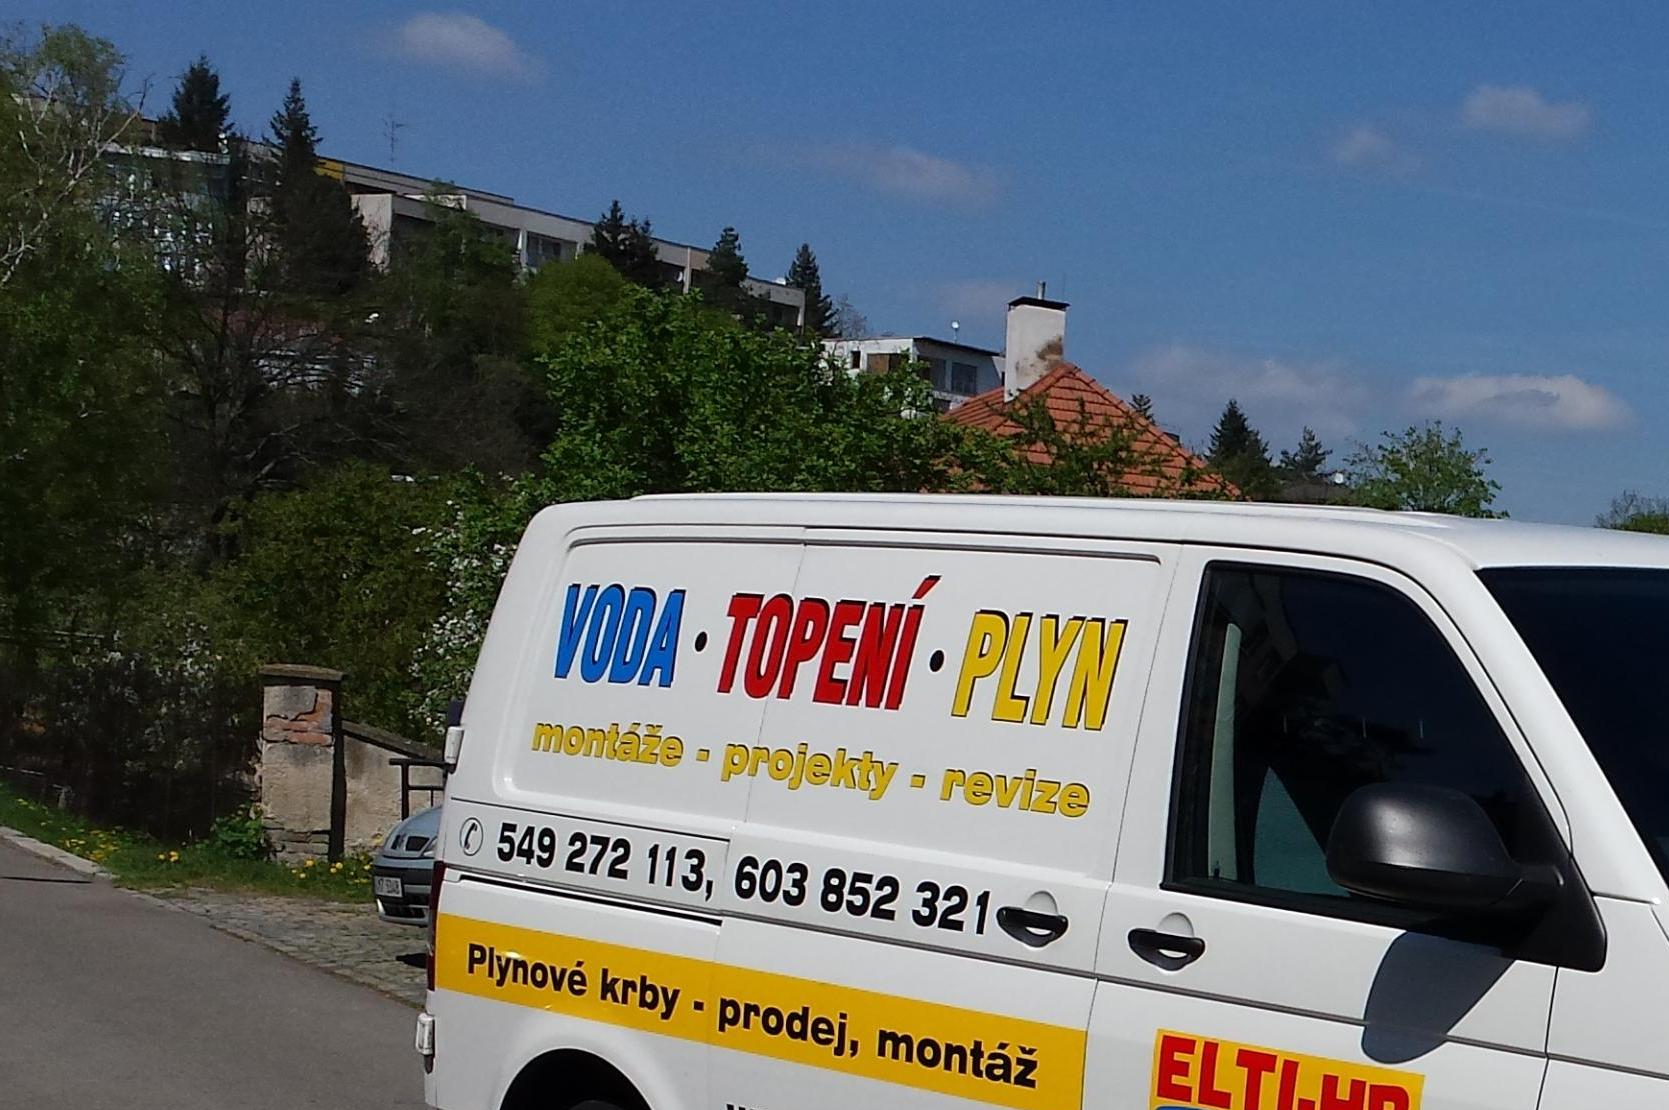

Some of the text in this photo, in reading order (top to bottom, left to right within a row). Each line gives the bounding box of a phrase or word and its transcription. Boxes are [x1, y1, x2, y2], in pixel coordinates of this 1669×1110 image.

[553, 574, 1129, 732] VODA TOPENÍ PLYN
[531, 722, 685, 767] montáže
[720, 742, 899, 801] projekty
[940, 768, 1091, 818] revize
[496, 822, 991, 935] 549 272 113, 603 852 321
[466, 942, 588, 997] Plynové
[600, 967, 681, 1020] krby
[718, 996, 860, 1057] prodej,
[877, 1028, 1039, 1089] montáž
